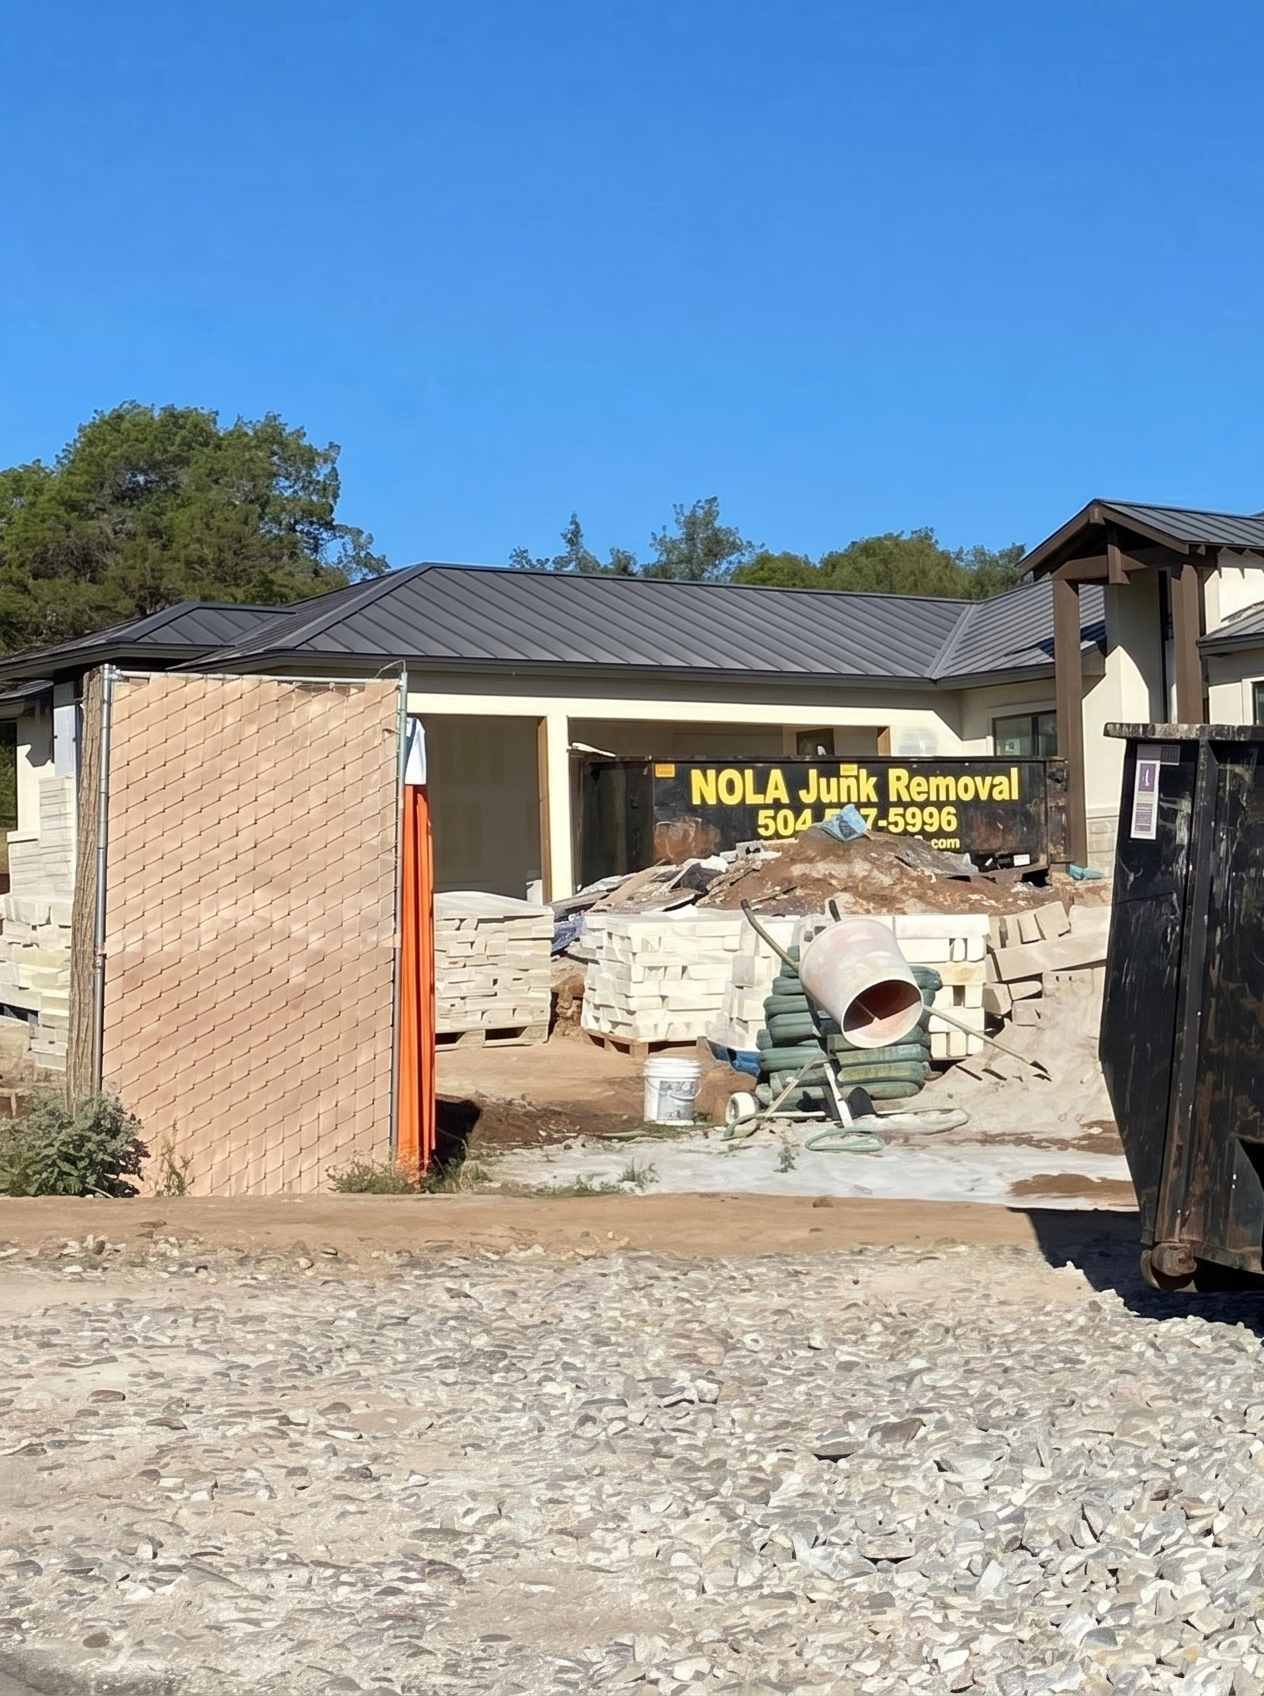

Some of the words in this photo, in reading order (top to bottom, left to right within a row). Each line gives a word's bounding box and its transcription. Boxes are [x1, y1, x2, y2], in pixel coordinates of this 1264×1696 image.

[690, 768, 790, 806] NOLA
[797, 767, 879, 804] Junk
[886, 766, 1020, 803] Removal
